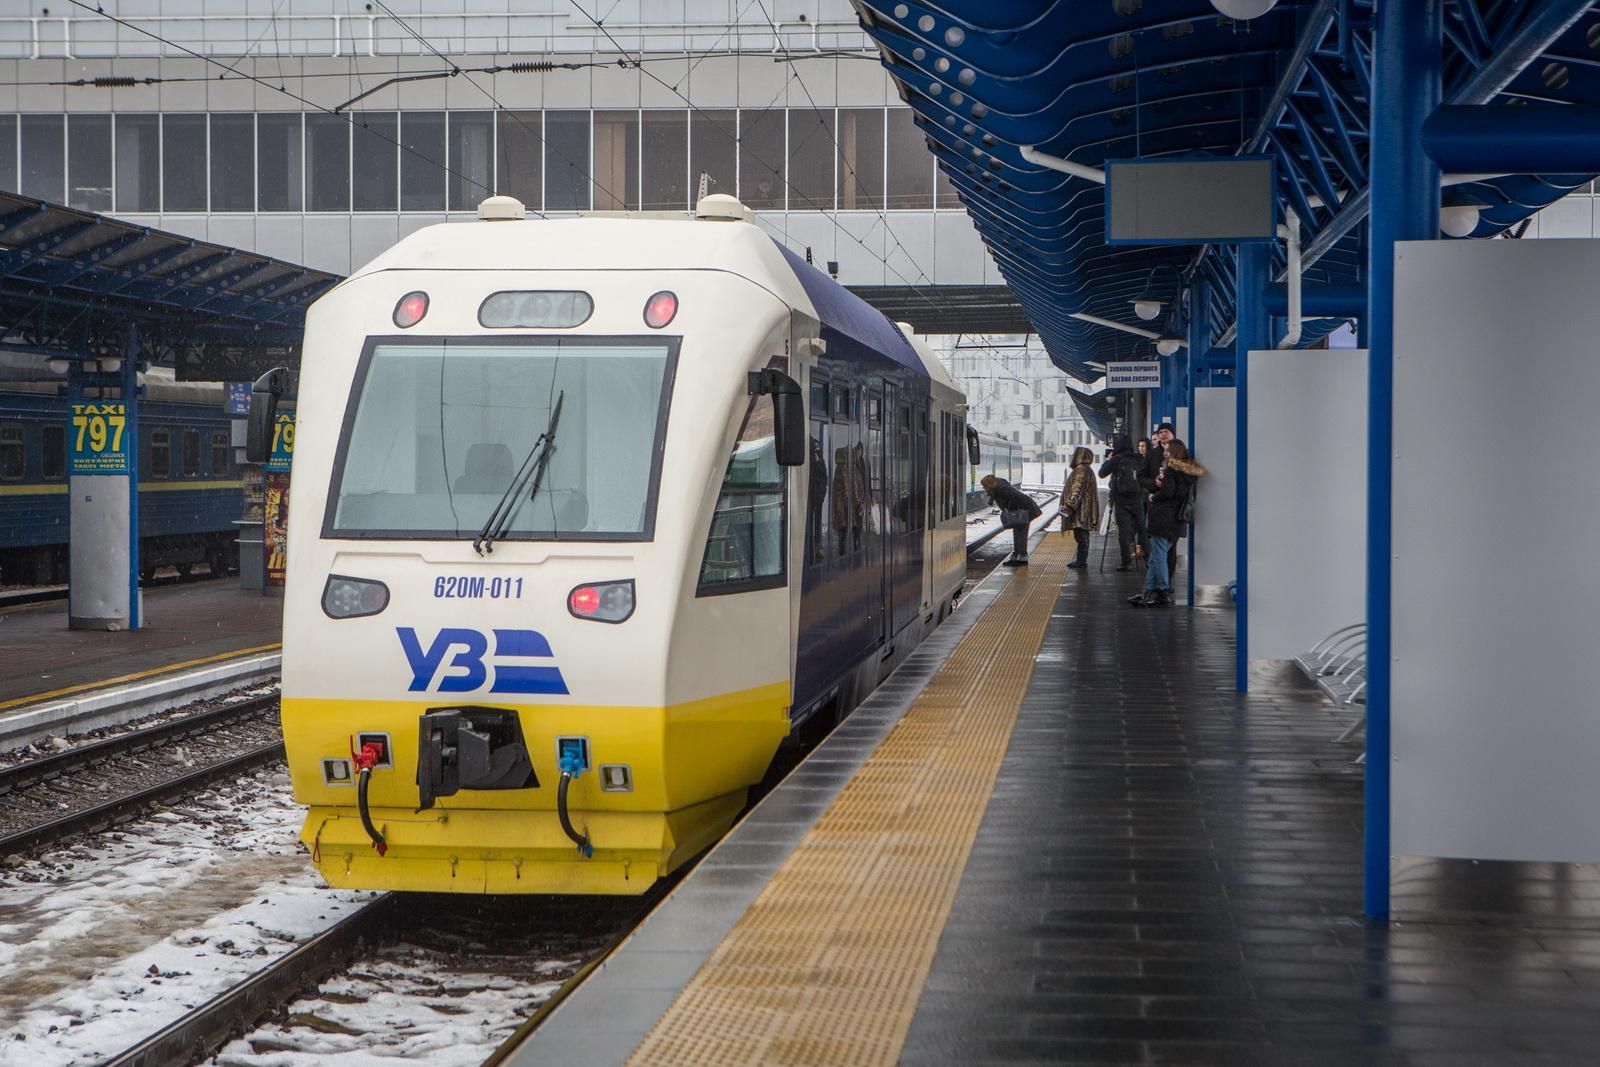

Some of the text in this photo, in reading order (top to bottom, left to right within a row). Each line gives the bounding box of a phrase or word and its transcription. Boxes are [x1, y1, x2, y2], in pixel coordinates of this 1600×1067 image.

[72, 404, 126, 415] TAXI
[73, 416, 126, 452] 797
[434, 576, 523, 598] 620M-011
